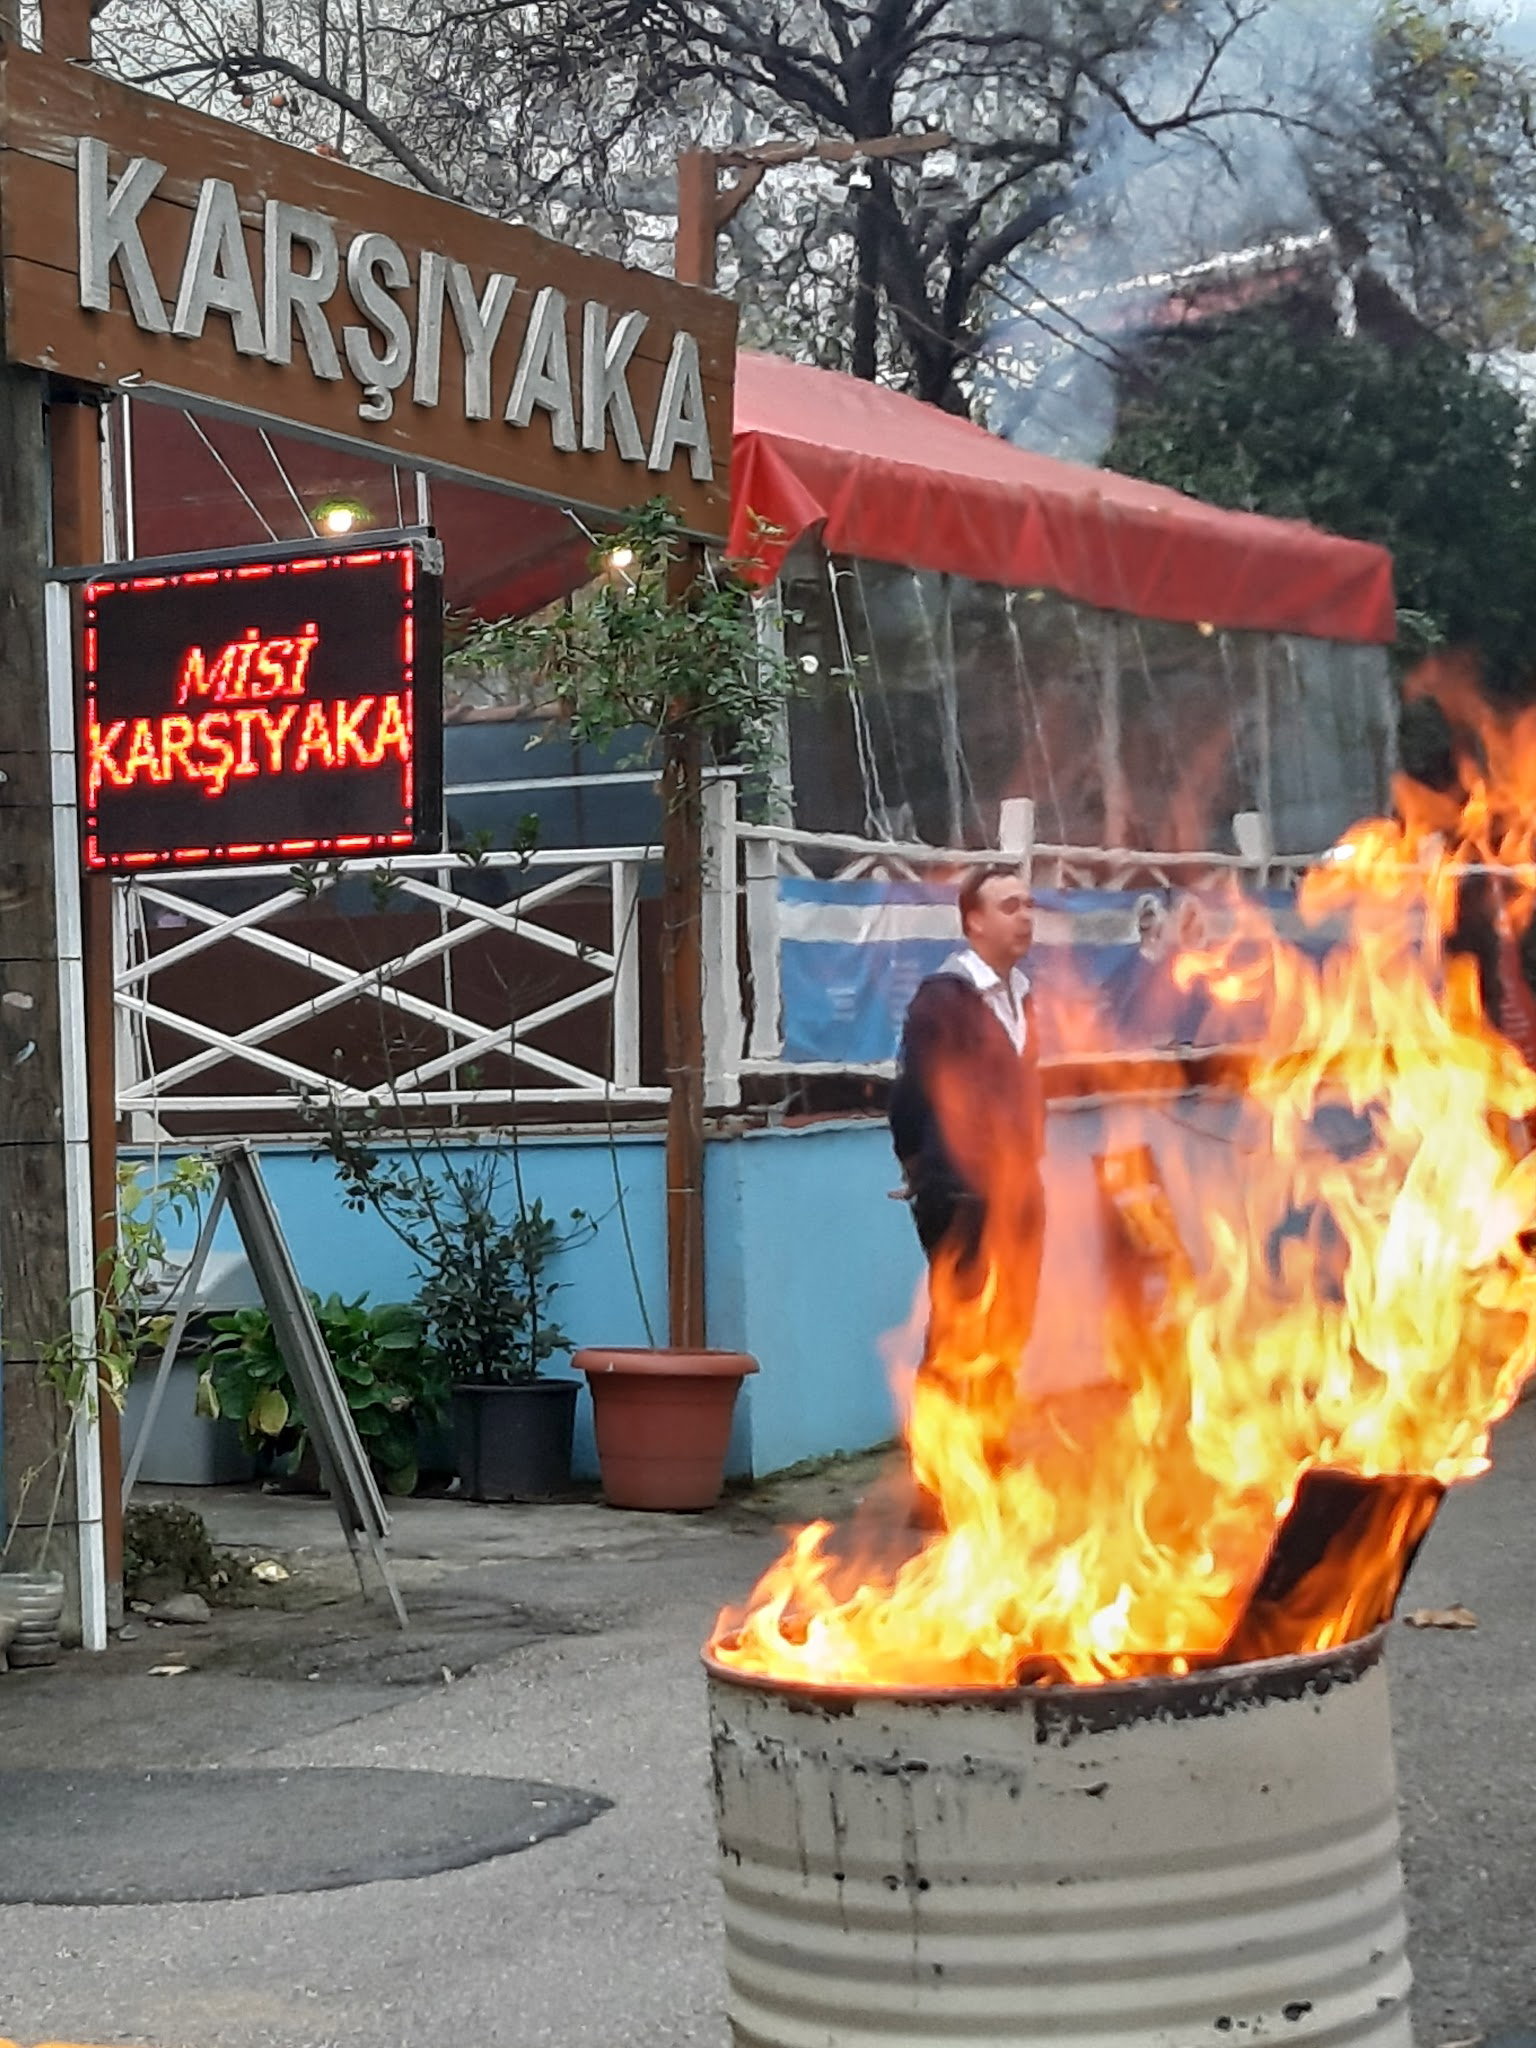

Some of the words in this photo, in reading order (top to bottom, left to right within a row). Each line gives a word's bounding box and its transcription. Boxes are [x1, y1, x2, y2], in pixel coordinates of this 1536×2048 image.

[77, 137, 714, 481] KARŞIYAKA
[176, 622, 319, 705] MİSİ
[88, 694, 410, 796] KARŞIYAKA
